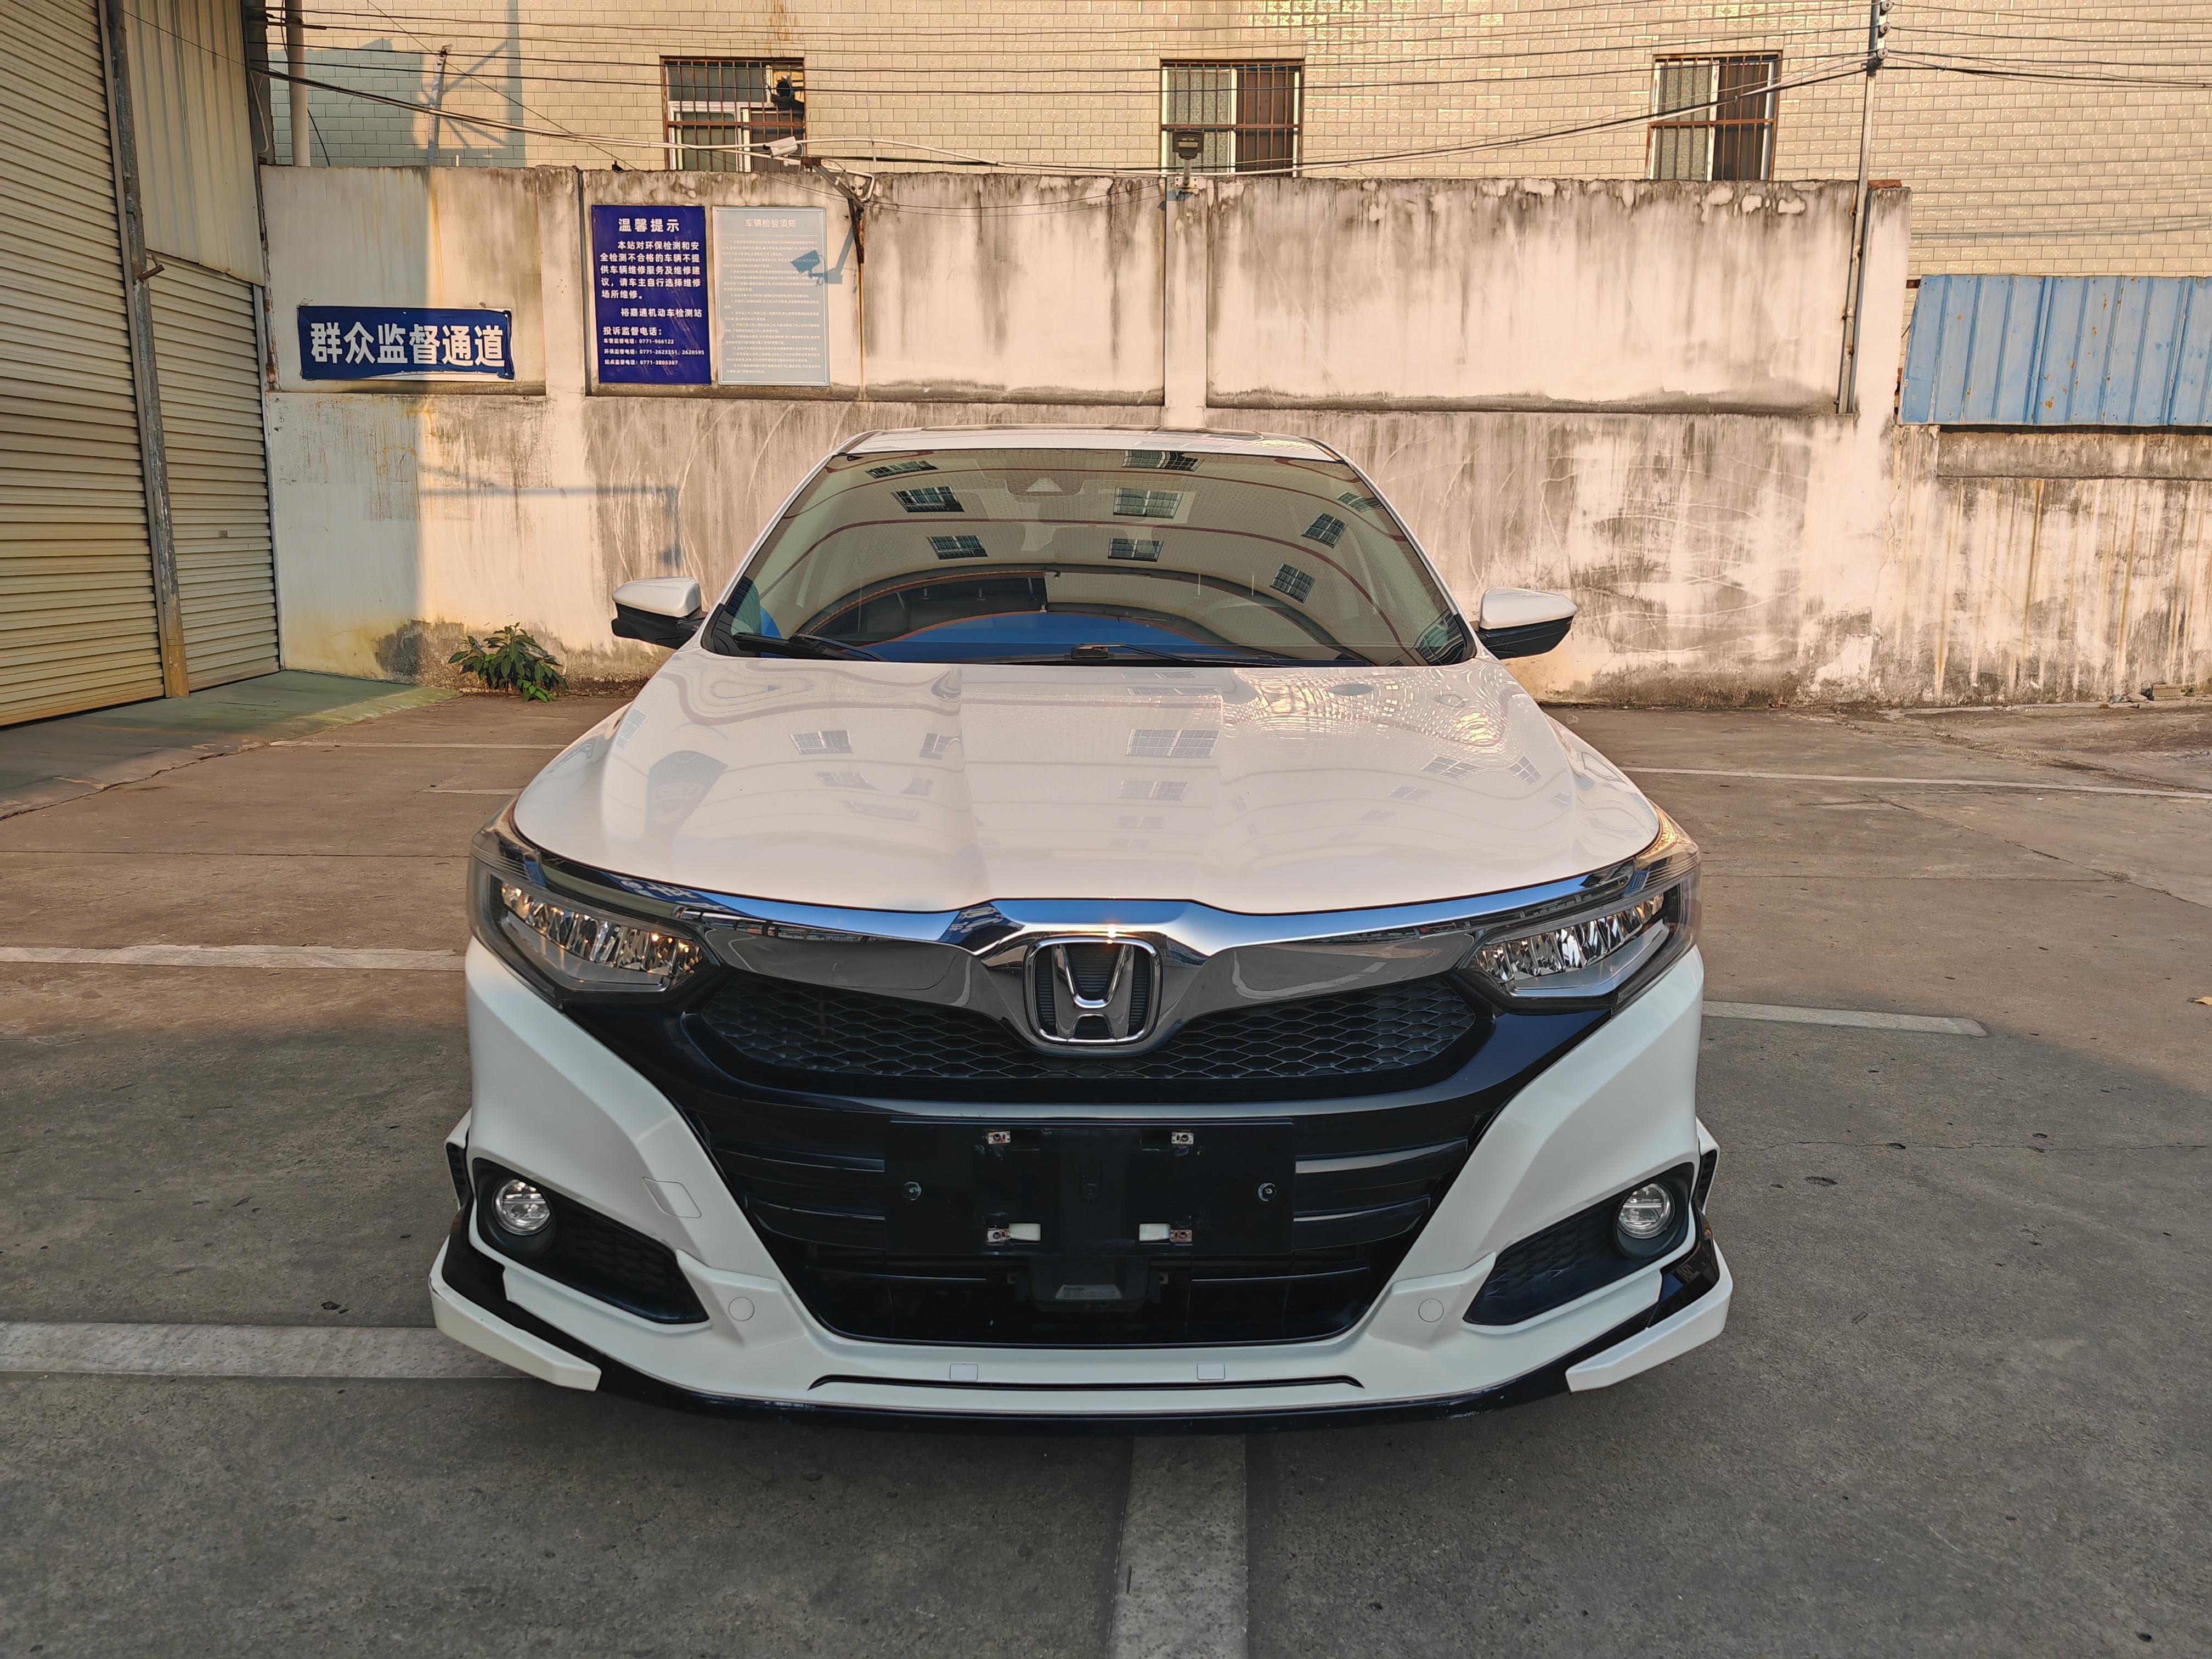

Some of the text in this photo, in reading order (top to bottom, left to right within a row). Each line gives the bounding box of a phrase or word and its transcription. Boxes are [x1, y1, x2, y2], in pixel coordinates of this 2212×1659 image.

[618, 218, 680, 233] 温馨提示
[745, 218, 797, 228] 车辆检验须知
[617, 240, 699, 251] 本站对环保检测和安
[600, 252, 701, 263] 全检测不合格的车辆不提
[600, 264, 701, 275] 供车辆维修服务及维修建
[601, 276, 701, 288] 议，请车主自行选择维修
[601, 289, 643, 300] 场所维修。
[620, 307, 703, 318] 裕嘉通机动车检测站
[603, 326, 662, 336] 投诉监督电话：
[310, 321, 505, 368] 群众监督通道
